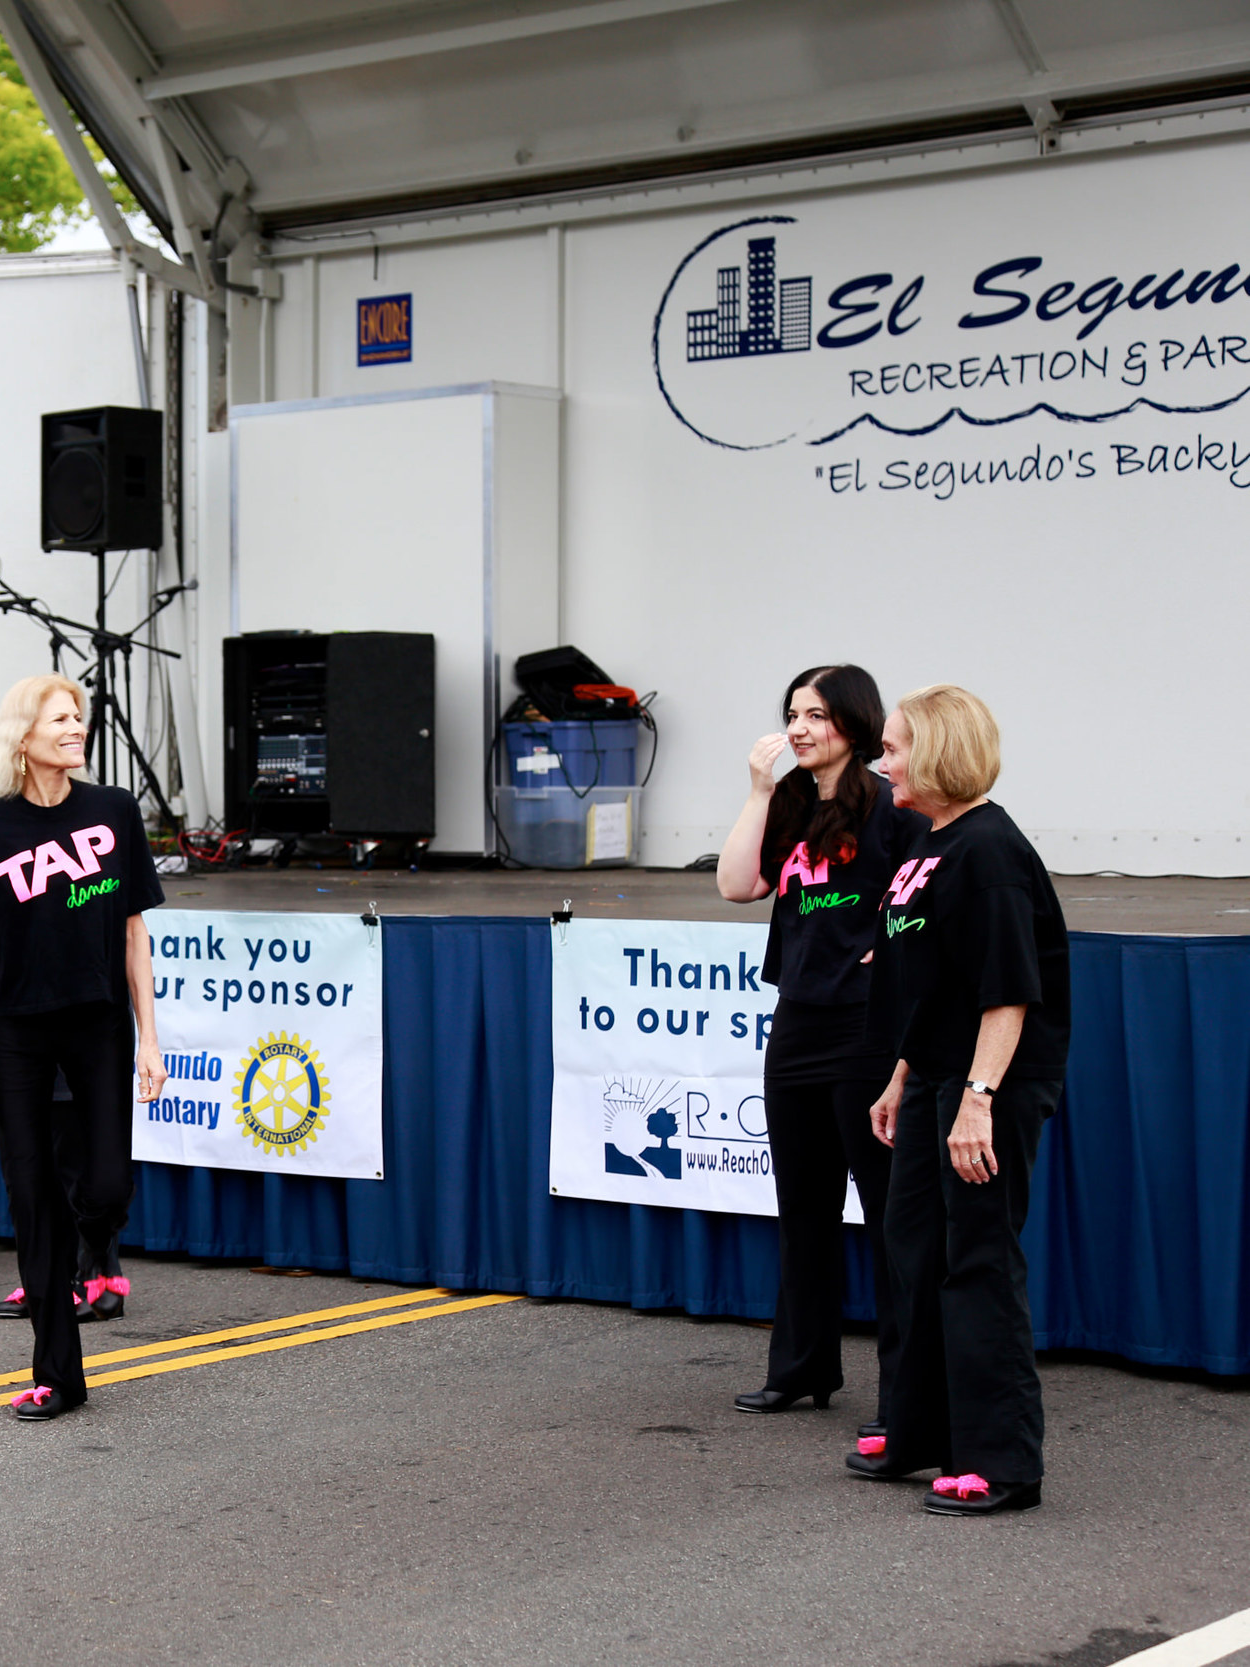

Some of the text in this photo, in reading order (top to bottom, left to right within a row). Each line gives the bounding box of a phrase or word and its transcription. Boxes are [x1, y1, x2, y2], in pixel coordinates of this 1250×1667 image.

[816, 256, 1250, 348] El Segun
[848, 346, 1109, 397] RECREATION
[1122, 342, 1148, 386] &
[878, 445, 1097, 500] Segundo's
[66, 877, 120, 908] dance
[798, 890, 860, 915] dance
[244, 937, 311, 971] you
[623, 948, 760, 991] Thank
[201, 976, 353, 1011] sponsor
[579, 996, 615, 1031] to
[637, 1007, 710, 1036] our
[262, 1043, 306, 1061] ROTARY
[148, 1096, 221, 1130] Rotary
[244, 1112, 316, 1144] INTERNATIONAL
[686, 1147, 775, 1176] www.ReachO
